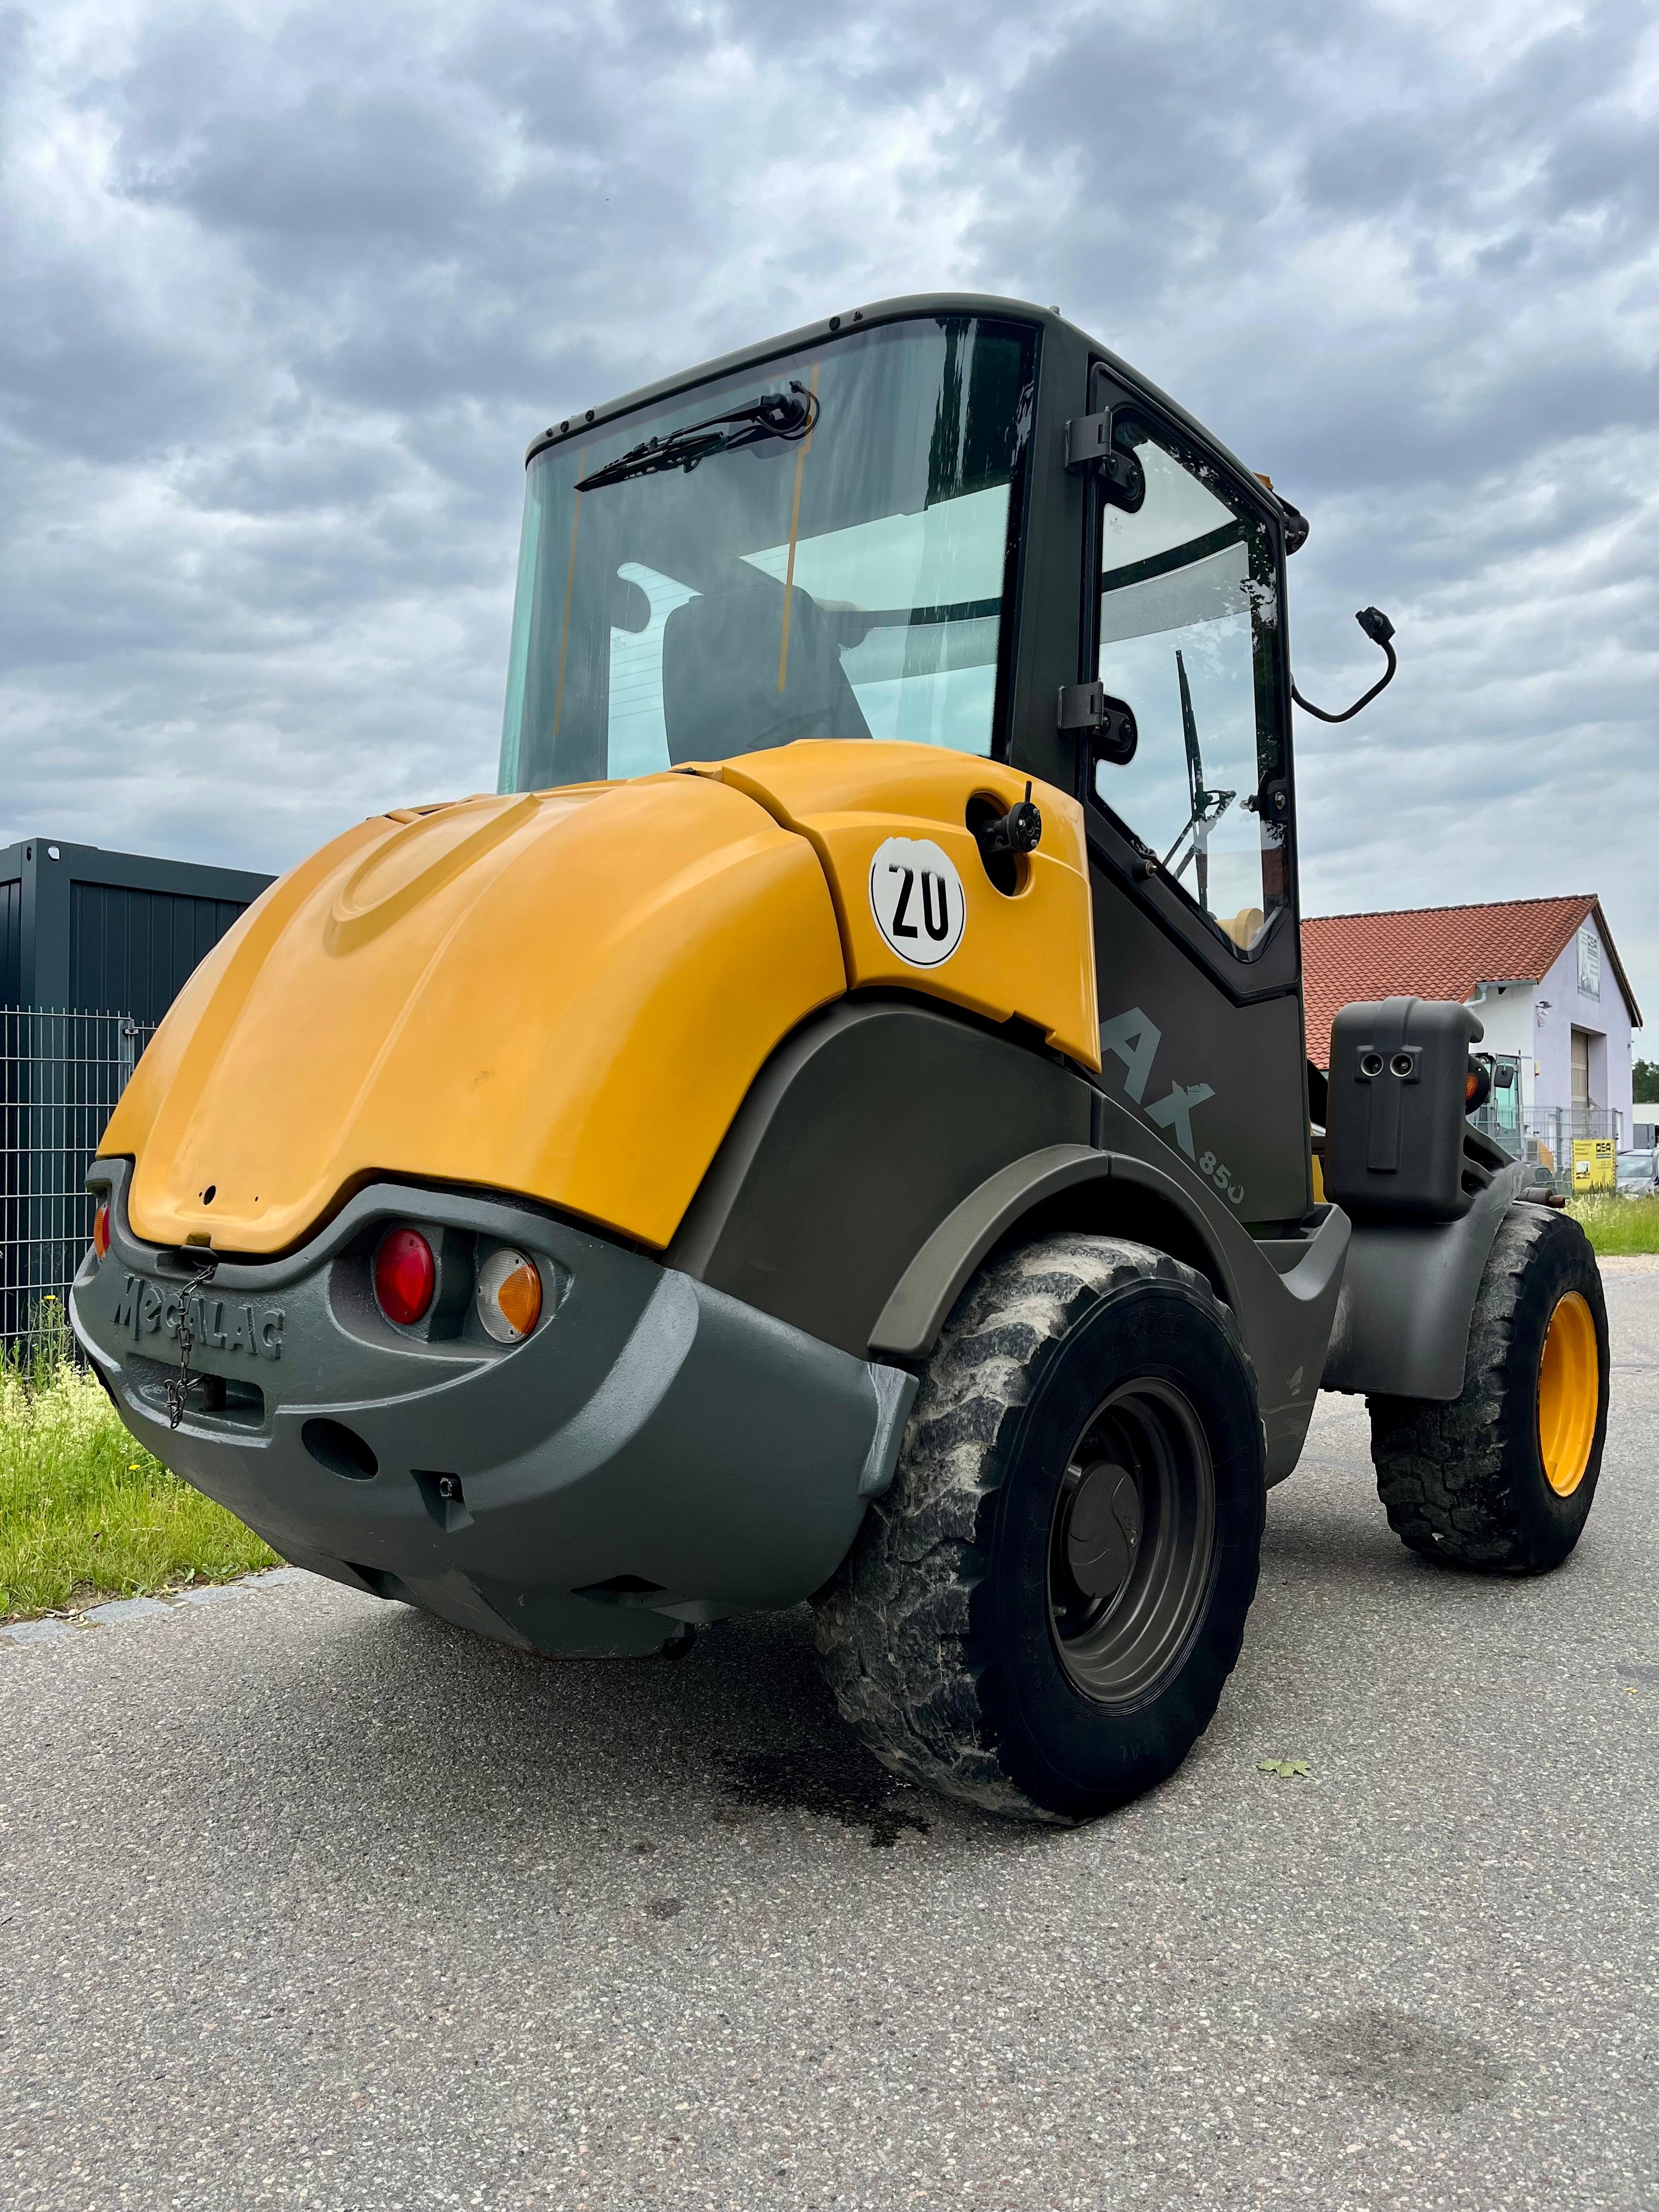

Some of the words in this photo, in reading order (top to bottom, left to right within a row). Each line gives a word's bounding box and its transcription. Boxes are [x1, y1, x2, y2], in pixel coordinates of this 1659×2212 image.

[889, 862, 949, 941] 20
[1099, 1006, 1216, 1164] AX
[1199, 1150, 1245, 1204] 850
